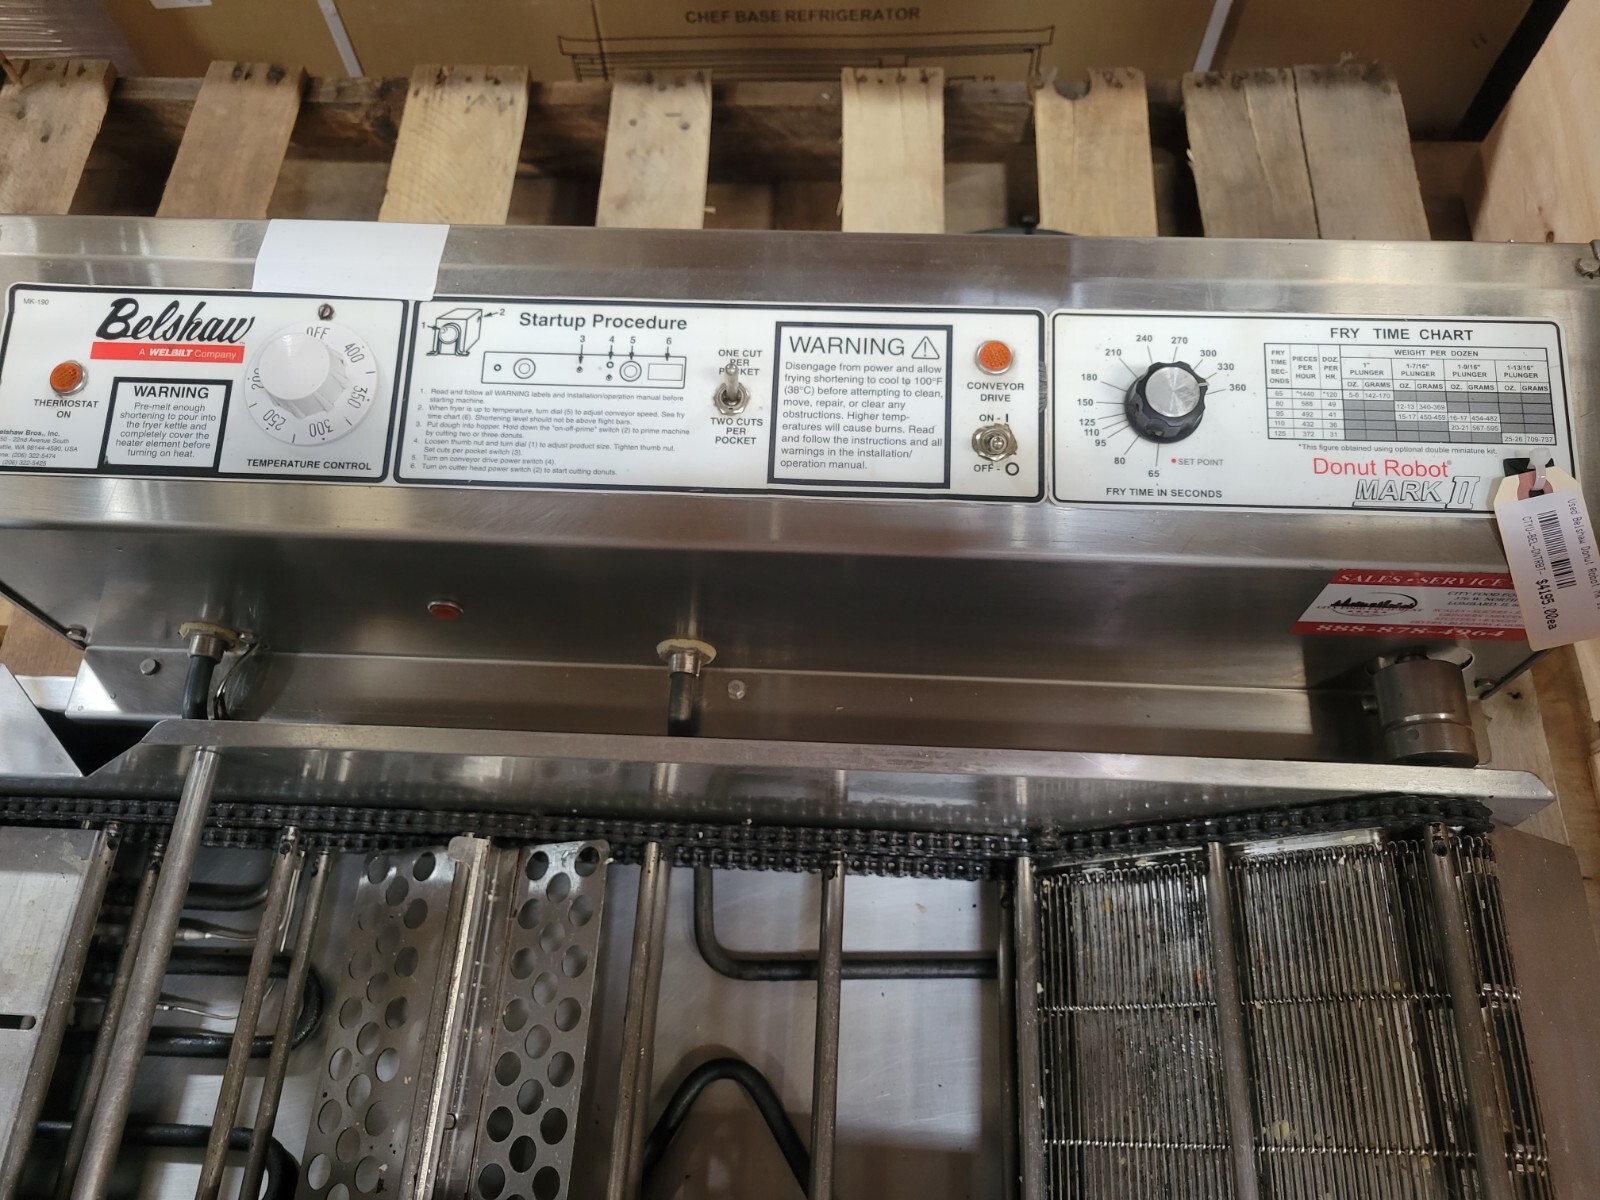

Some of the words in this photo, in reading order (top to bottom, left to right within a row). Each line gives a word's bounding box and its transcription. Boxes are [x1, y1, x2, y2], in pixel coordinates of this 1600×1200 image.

[685, 10, 729, 23] CHEF
[735, 10, 780, 23] BASE
[785, 7, 921, 22] REFRIGERATOR
[499, 308, 506, 316] 2
[96, 298, 255, 344] Belshaw
[421, 322, 426, 330] 1
[519, 312, 587, 331] Startup
[592, 314, 688, 330] Procedure
[1136, 334, 1153, 342] 240
[1330, 327, 1360, 339] FRY
[1373, 328, 1410, 340] TIME
[1420, 329, 1474, 341] CHART
[579, 335, 586, 344] 3
[630, 336, 636, 344] 5
[666, 337, 672, 345] 6
[1171, 336, 1188, 344] 270
[789, 336, 905, 356] WARNING
[149, 348, 194, 357] WELBILT
[194, 350, 236, 360] Company
[344, 342, 366, 363] 400
[718, 349, 740, 358] ONE
[742, 350, 763, 358] CUT
[1200, 350, 1217, 358] 300
[730, 359, 750, 367] PER
[785, 362, 837, 372] Disengage
[839, 362, 861, 372] from
[863, 364, 894, 374] power
[896, 364, 915, 373] and
[917, 365, 942, 374] allow
[1217, 363, 1235, 371] 330
[718, 368, 760, 376] PKET
[784, 374, 811, 385] frying
[814, 374, 864, 386] shortening
[867, 376, 876, 384] to
[878, 376, 900, 384] cool
[902, 377, 911, 386] to
[966, 382, 1024, 391] CONVEYOR
[1229, 384, 1247, 392] 360
[134, 385, 210, 399] WARNING
[346, 384, 369, 409] 350
[818, 386, 848, 396] before
[850, 388, 900, 398] attempting
[903, 388, 912, 397] to
[914, 388, 944, 398] clean,
[34, 398, 99, 408] THERMOSTAT
[980, 394, 1012, 402] DRIVE
[1077, 398, 1094, 406] 150
[134, 402, 171, 412] Pre-melt
[172, 403, 206, 414] enough
[783, 400, 812, 408] move,
[816, 399, 846, 409] repair,
[862, 400, 885, 408] clear
[888, 402, 906, 410] any
[56, 410, 72, 419] ON
[120, 411, 166, 421] shortening
[168, 412, 176, 420] to
[178, 414, 198, 422] pour
[200, 413, 217, 422] into
[782, 410, 844, 420] obstructions.
[847, 412, 879, 422] Higher
[882, 412, 910, 422] temp-
[978, 414, 994, 422] ON
[126, 420, 140, 428] the
[142, 421, 162, 430] fryer
[190, 422, 207, 430] and
[262, 409, 287, 431] 250
[710, 417, 734, 426] TWO
[736, 418, 764, 426] CUTS
[1079, 418, 1096, 426] 125
[308, 418, 334, 438] 300
[726, 427, 746, 436] PER
[782, 422, 822, 432] eratures
[824, 423, 840, 432] will
[842, 424, 872, 432] cause
[874, 424, 905, 434] burns.
[908, 425, 935, 434] Read
[1084, 428, 1100, 436] 110
[120, 430, 167, 440] completely
[116, 438, 144, 447] heater
[146, 440, 181, 448] element
[182, 440, 211, 449] before
[714, 436, 757, 445] POCKET
[781, 434, 800, 443] and
[802, 435, 830, 444] follow
[833, 436, 848, 444] the
[851, 436, 907, 446] instructions
[910, 438, 928, 446] and
[931, 438, 943, 447] all
[1094, 439, 1106, 447] 95
[128, 449, 158, 458] turning
[173, 450, 195, 458] heat.
[781, 447, 824, 458] warnings
[828, 448, 836, 456] in
[838, 448, 854, 457] the
[857, 449, 912, 458] installation/
[1374, 446, 1393, 454] using
[247, 458, 320, 469] TEMPERATURE
[323, 460, 372, 471] CONTROL
[780, 459, 826, 469] operation
[828, 460, 868, 470] manual.
[1114, 457, 1126, 465] 80
[1178, 458, 1195, 466] SET
[1197, 458, 1224, 466] POINT
[973, 464, 994, 473] OFF
[1313, 457, 1376, 476] Donut
[1384, 459, 1448, 478] Robot
[1148, 470, 1160, 478] 65
[1106, 488, 1126, 496] FRY
[1129, 488, 1154, 496] TIME
[1157, 488, 1168, 497] IN
[1170, 489, 1222, 498] SECONDS
[1356, 478, 1443, 502] MARK
[1567, 498, 1578, 515] Used
[1572, 516, 1586, 545] Belshaw
[1580, 546, 1594, 566] Donut
[1338, 574, 1402, 584] SALES
[1416, 576, 1507, 586] SERVICE
[1535, 578, 1560, 631] $4195.00ea
[1315, 624, 1506, 638] 888-878-4964
